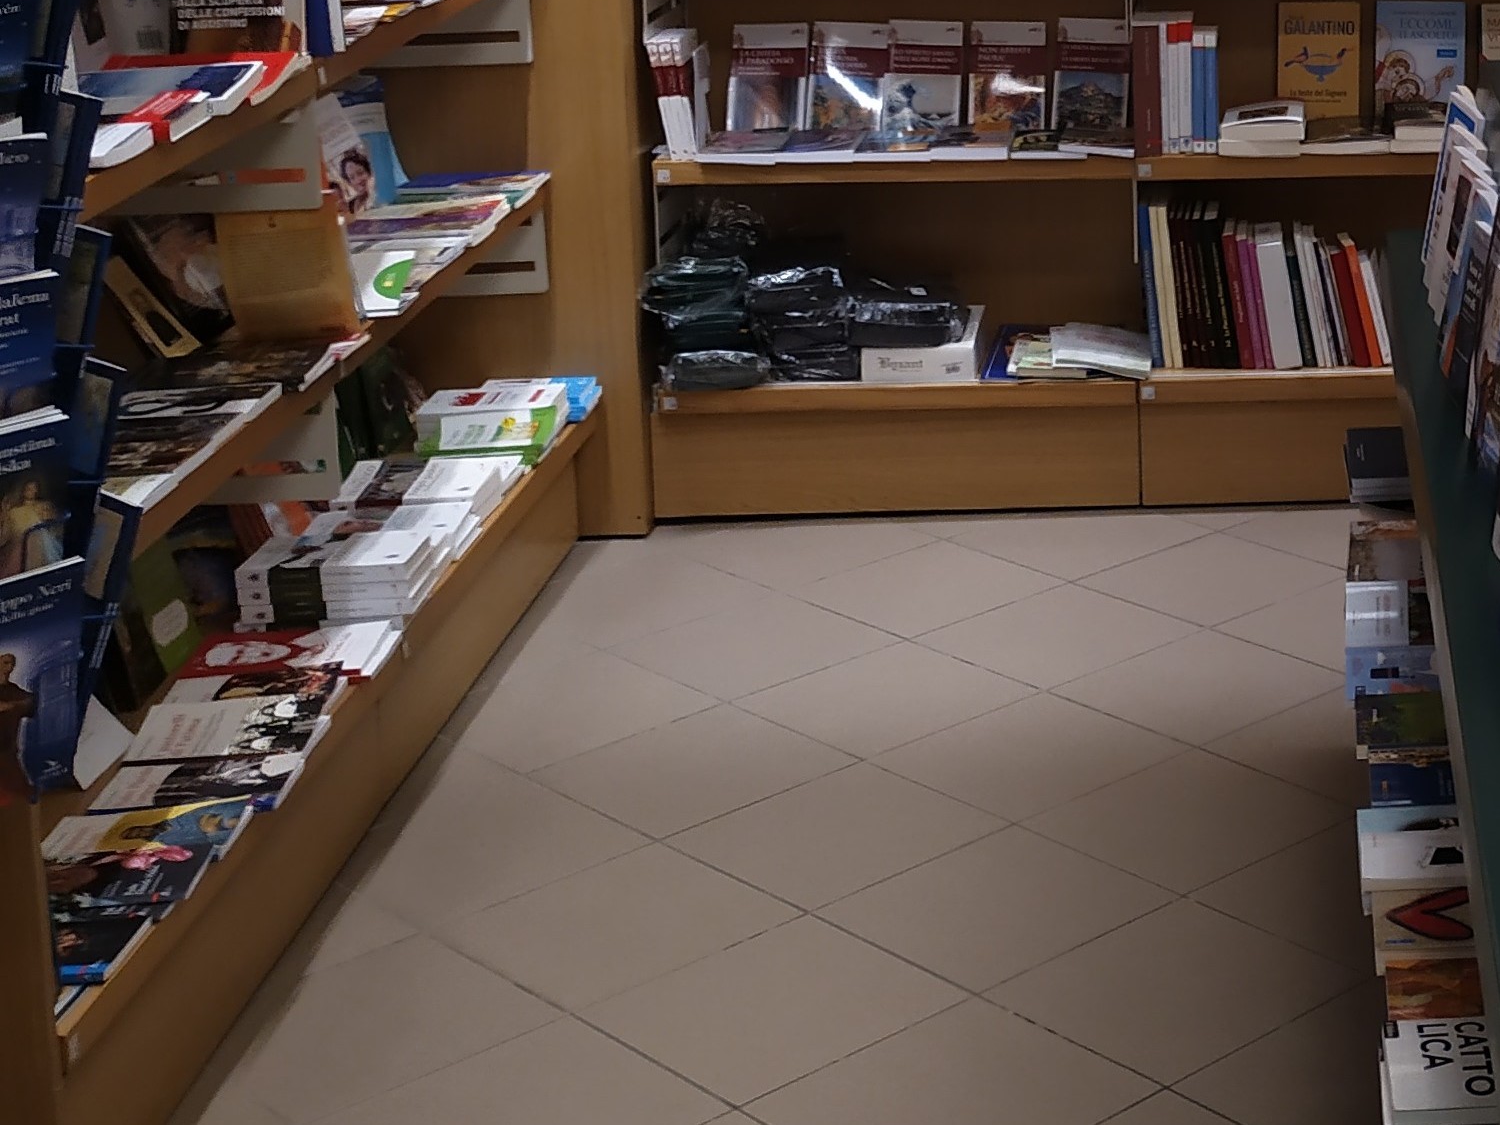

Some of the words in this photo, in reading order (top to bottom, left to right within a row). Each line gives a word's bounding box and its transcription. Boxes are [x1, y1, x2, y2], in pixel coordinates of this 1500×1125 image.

[1283, 18, 1355, 36] GALANTINO
[1416, 1022, 1456, 1072] LICA
[1453, 1020, 1497, 1097] CATTO
